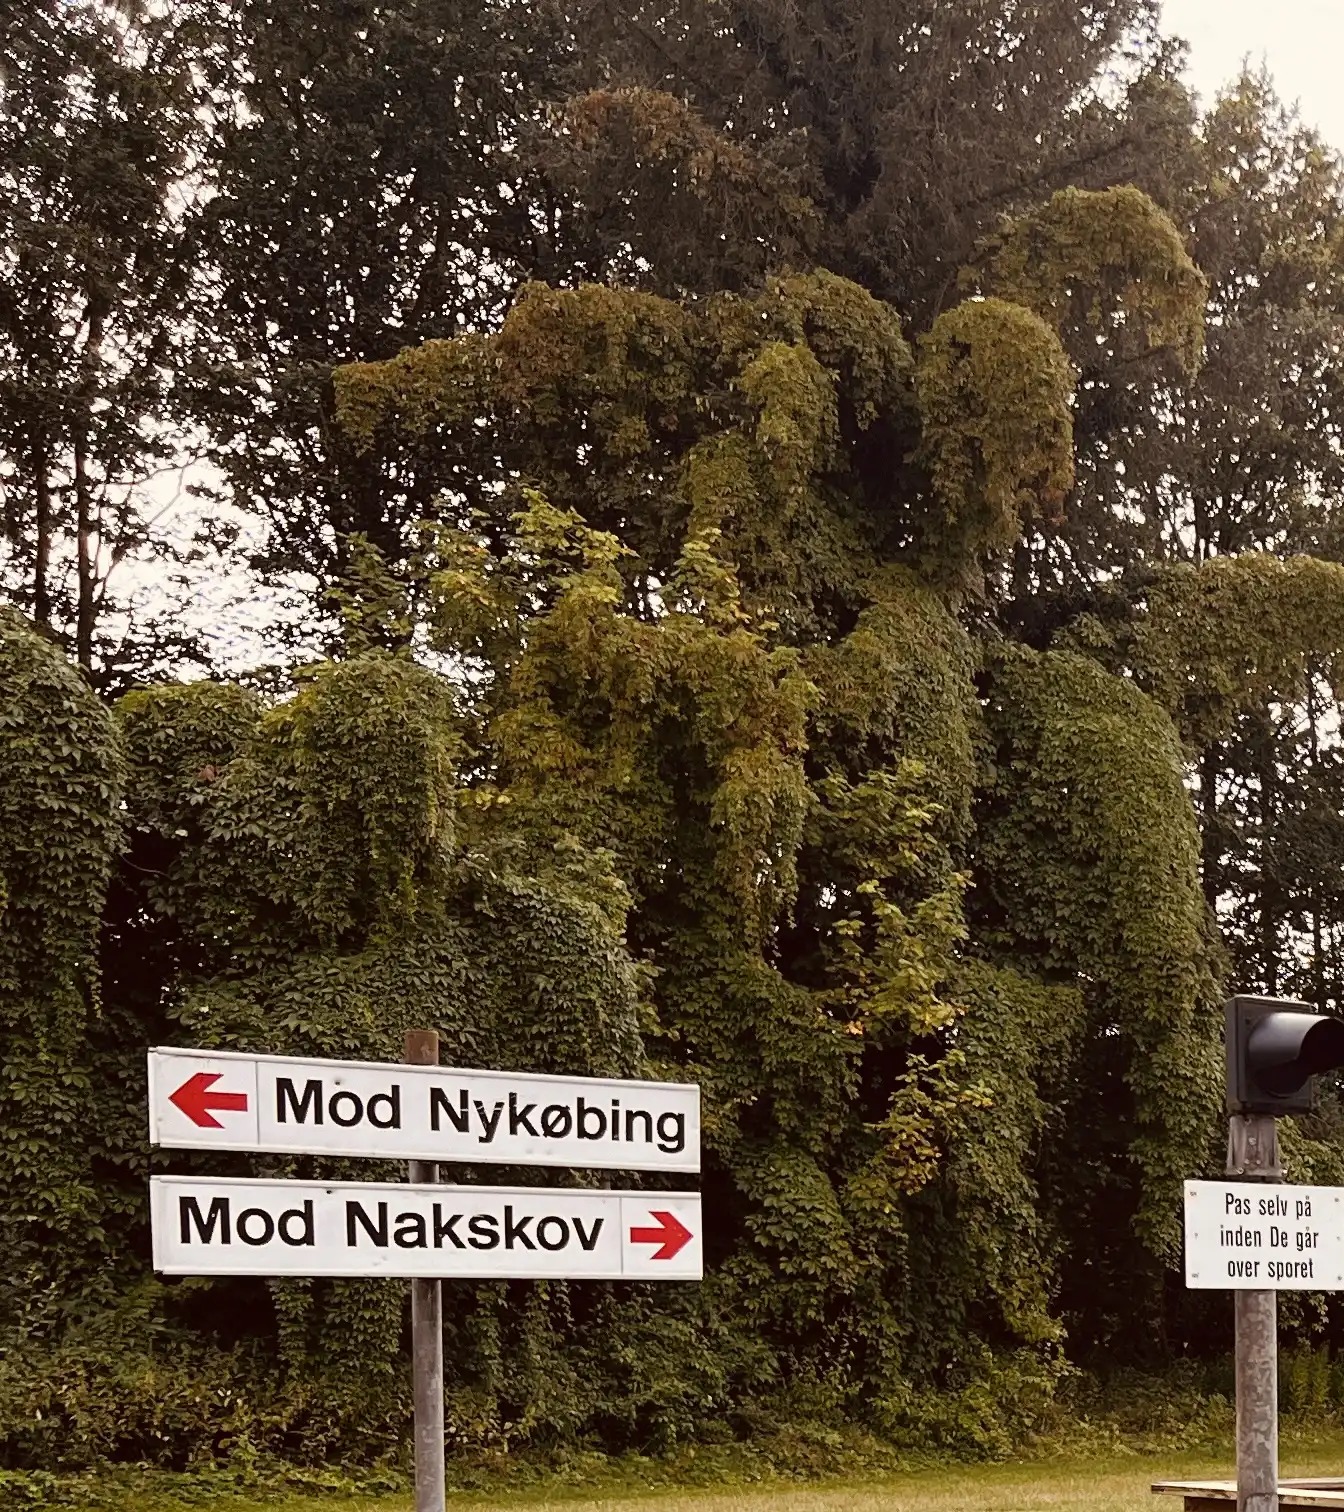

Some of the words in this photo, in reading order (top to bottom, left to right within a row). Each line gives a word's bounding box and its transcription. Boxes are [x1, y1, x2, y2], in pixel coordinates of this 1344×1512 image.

[275, 1077, 401, 1130] Mod
[429, 1087, 686, 1154] Nykøbing
[1225, 1192, 1251, 1216] Pas
[1258, 1195, 1288, 1217] selv
[1296, 1195, 1312, 1220] på
[178, 1195, 315, 1247] Mod
[346, 1200, 604, 1252] Nakskov
[1220, 1224, 1262, 1248] inden
[1270, 1226, 1289, 1248] De
[1296, 1226, 1319, 1252] går
[1227, 1260, 1260, 1278] over
[1267, 1258, 1314, 1281] sporet
